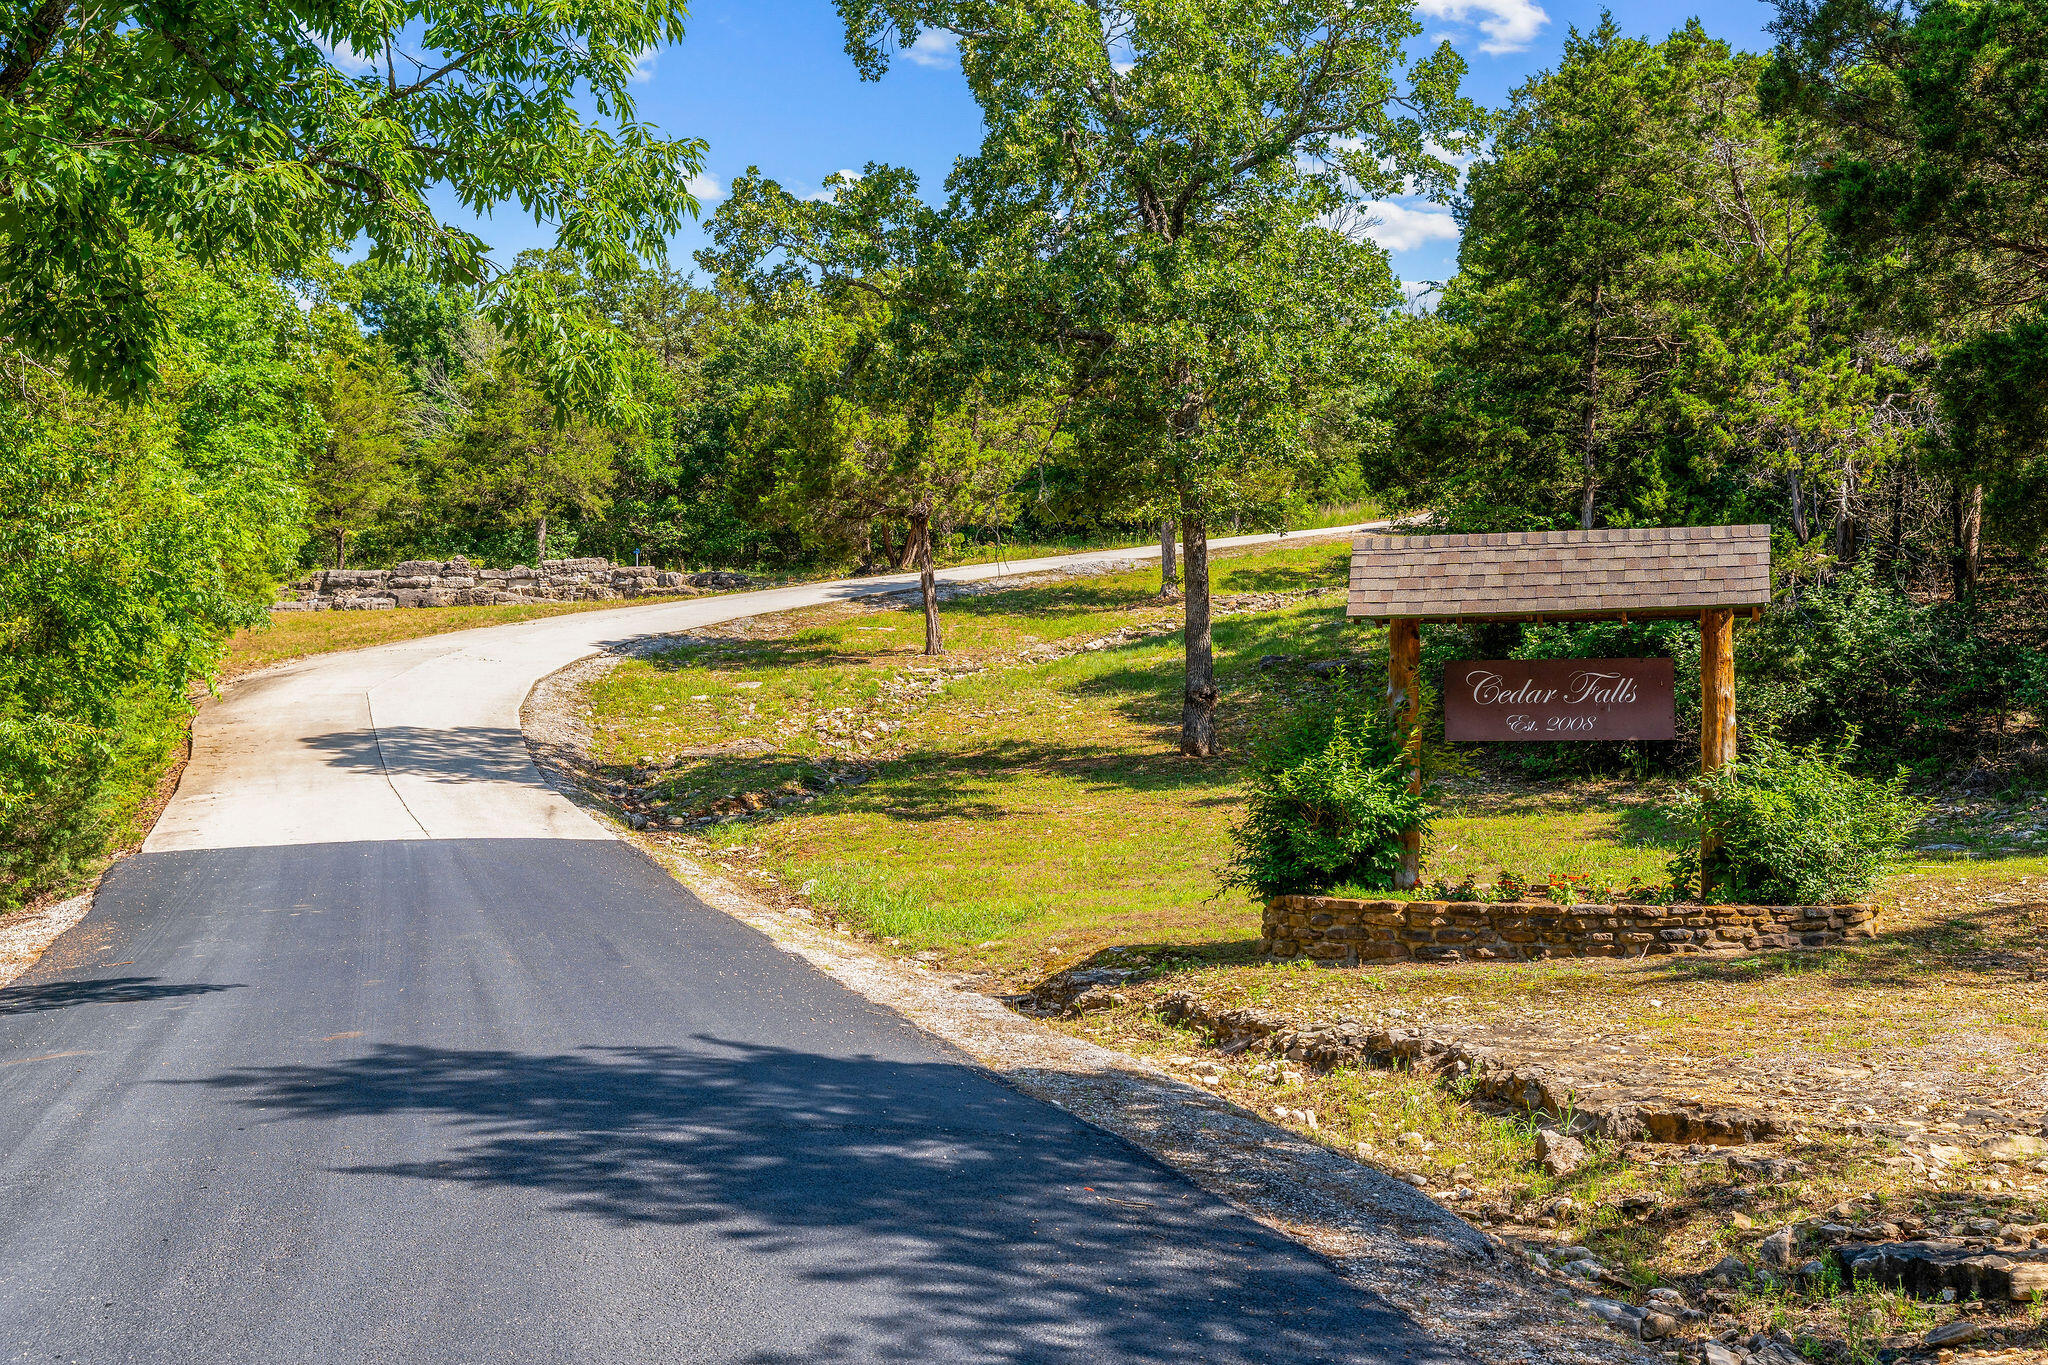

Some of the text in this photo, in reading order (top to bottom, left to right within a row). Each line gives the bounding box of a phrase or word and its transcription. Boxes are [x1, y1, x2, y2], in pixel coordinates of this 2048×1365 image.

[1466, 670, 1638, 706] Cedar Falls
[1506, 714, 1597, 734] Est. 2008
